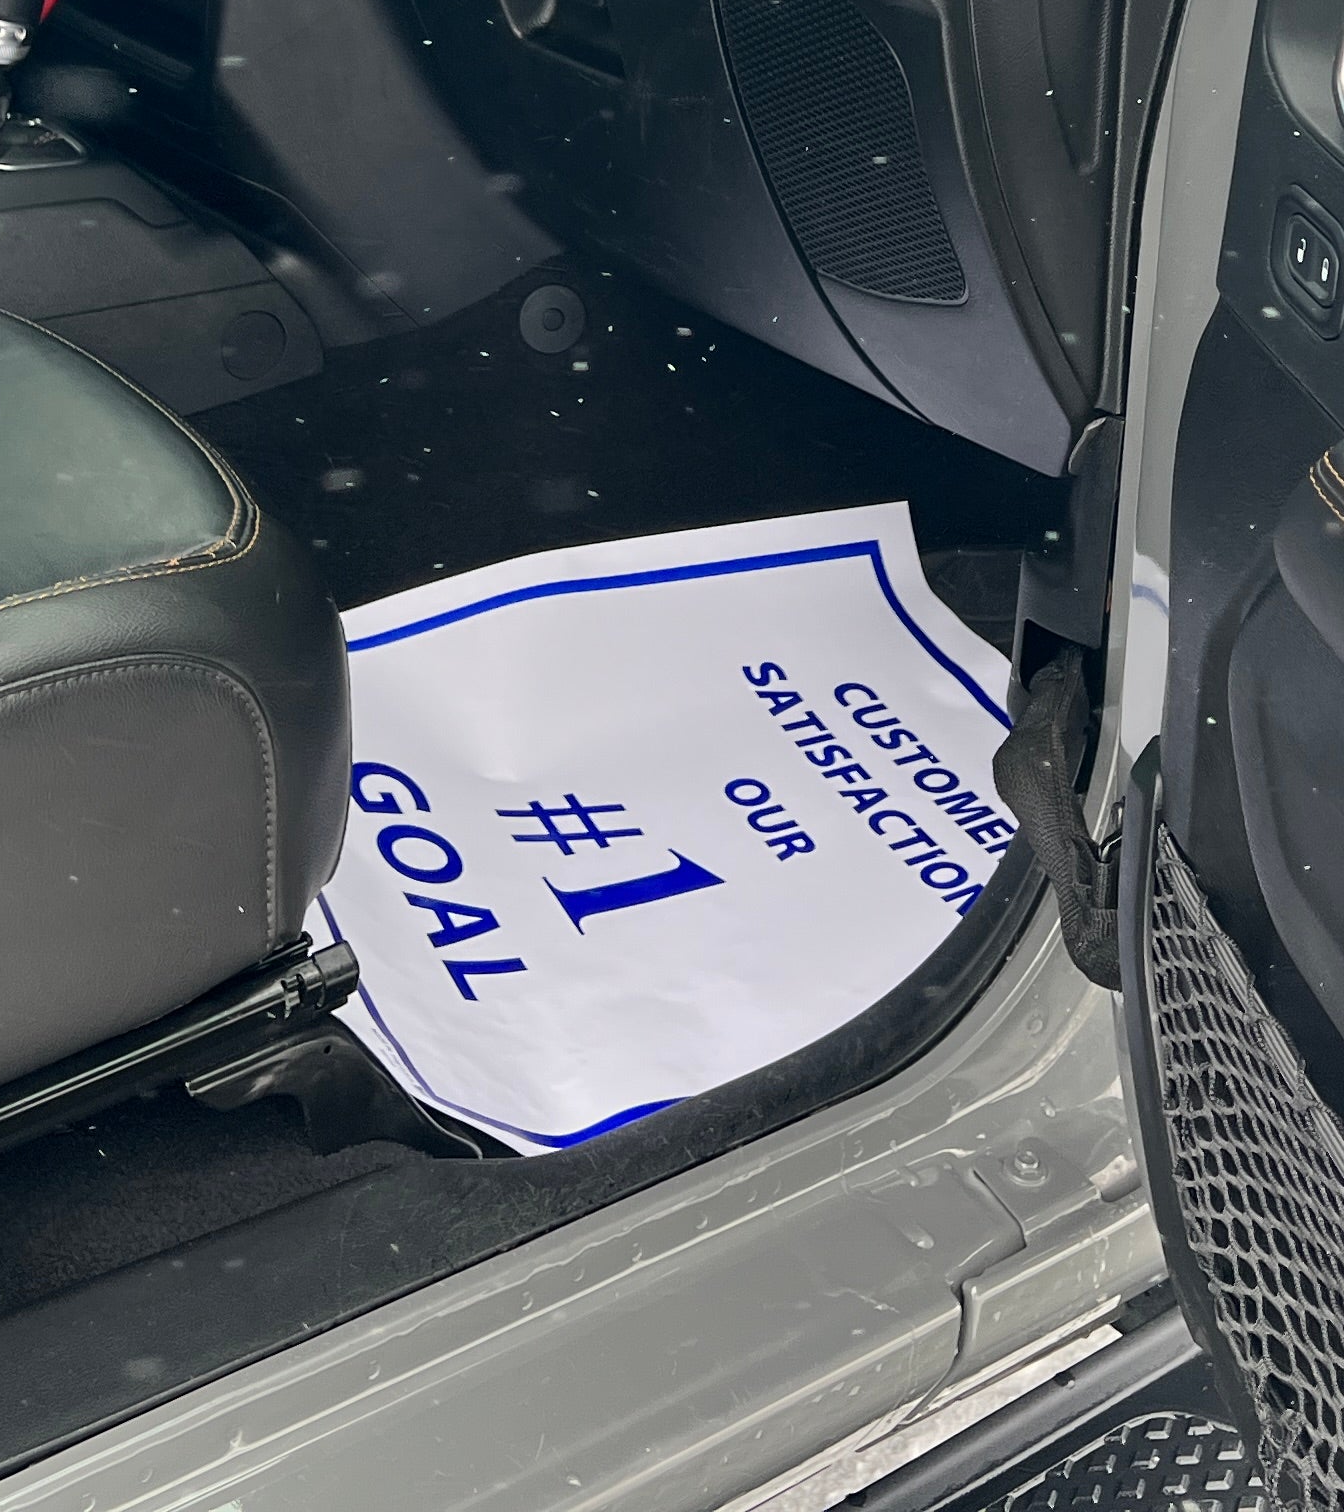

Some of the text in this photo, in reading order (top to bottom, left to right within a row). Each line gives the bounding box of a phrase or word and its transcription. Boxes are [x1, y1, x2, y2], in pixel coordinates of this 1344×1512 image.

[351, 761, 528, 1001] GOAL
[495, 793, 725, 935] #1
[725, 778, 816, 862] OUR
